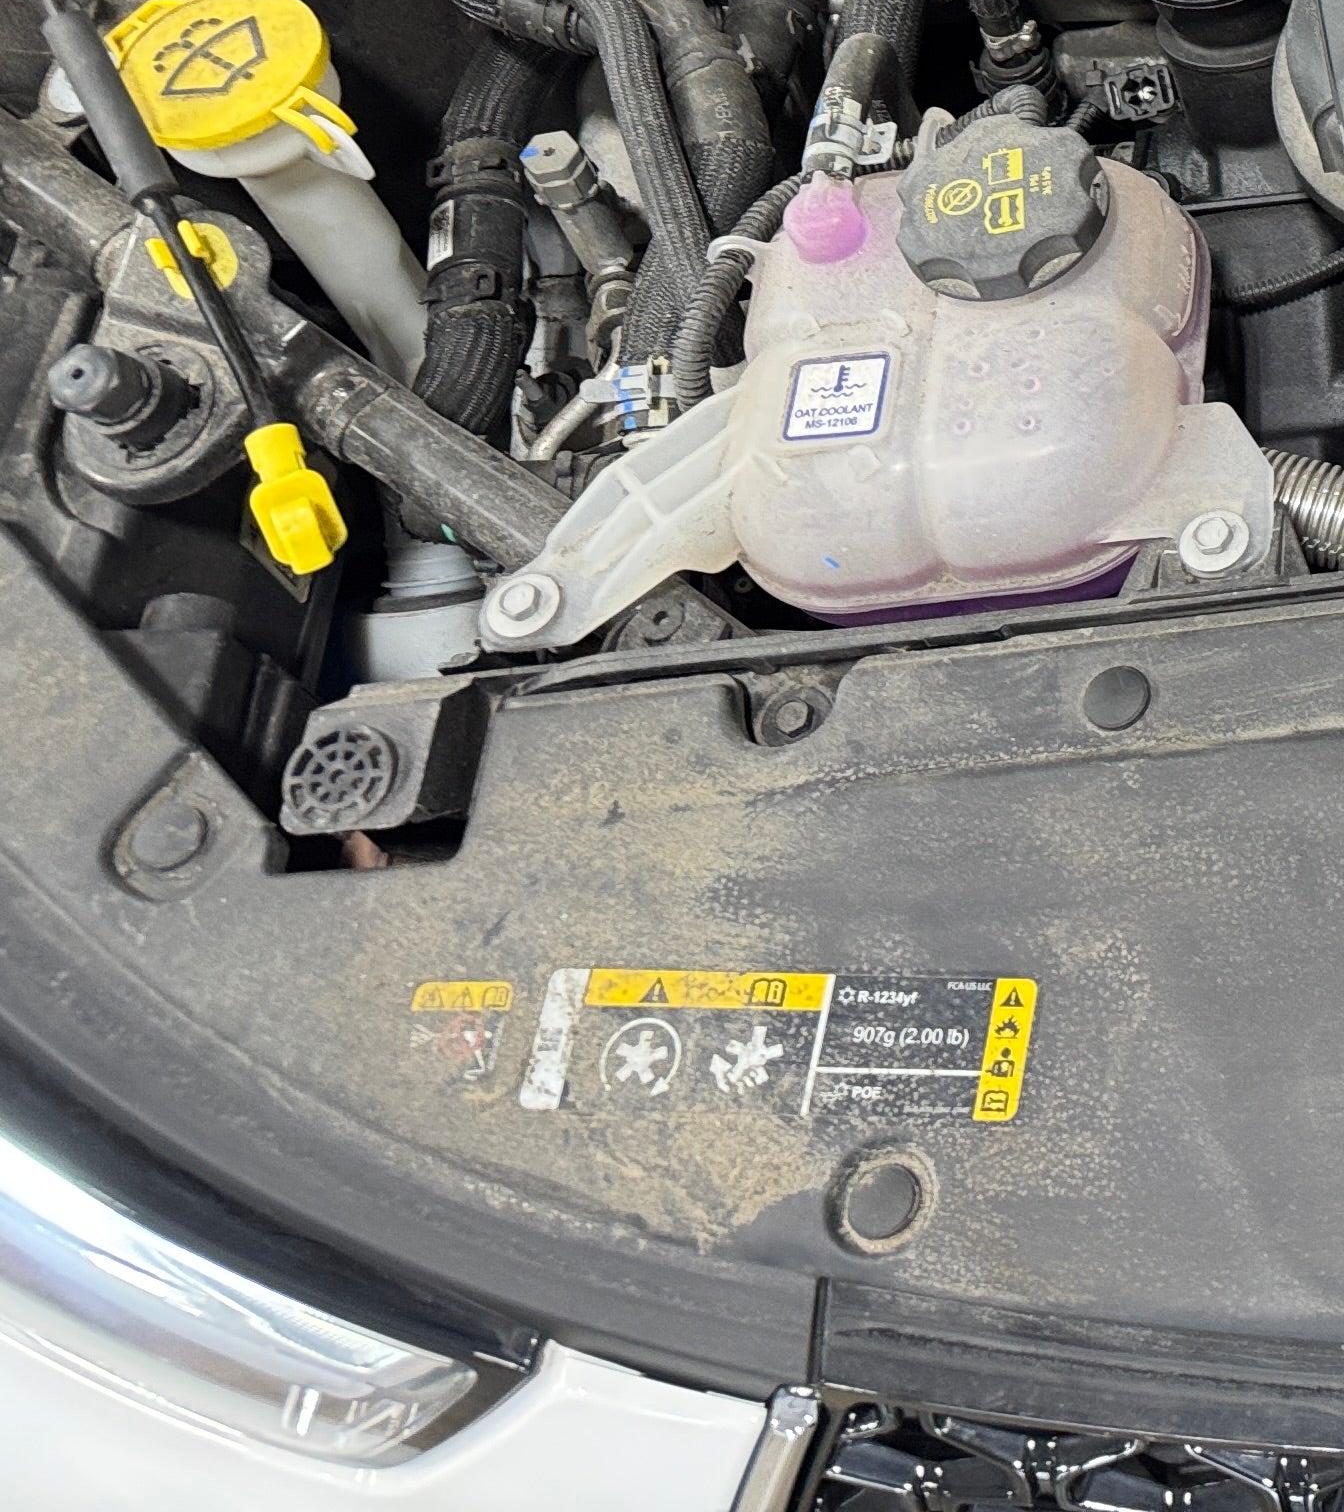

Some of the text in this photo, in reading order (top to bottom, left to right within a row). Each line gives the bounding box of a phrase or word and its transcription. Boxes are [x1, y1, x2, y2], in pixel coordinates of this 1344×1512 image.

[794, 402, 874, 419] OAT COOLANT
[857, 990, 920, 1008] R-1234yf
[852, 1026, 970, 1048] 907g (2.00 lb)
[851, 1085, 883, 1100] POE
